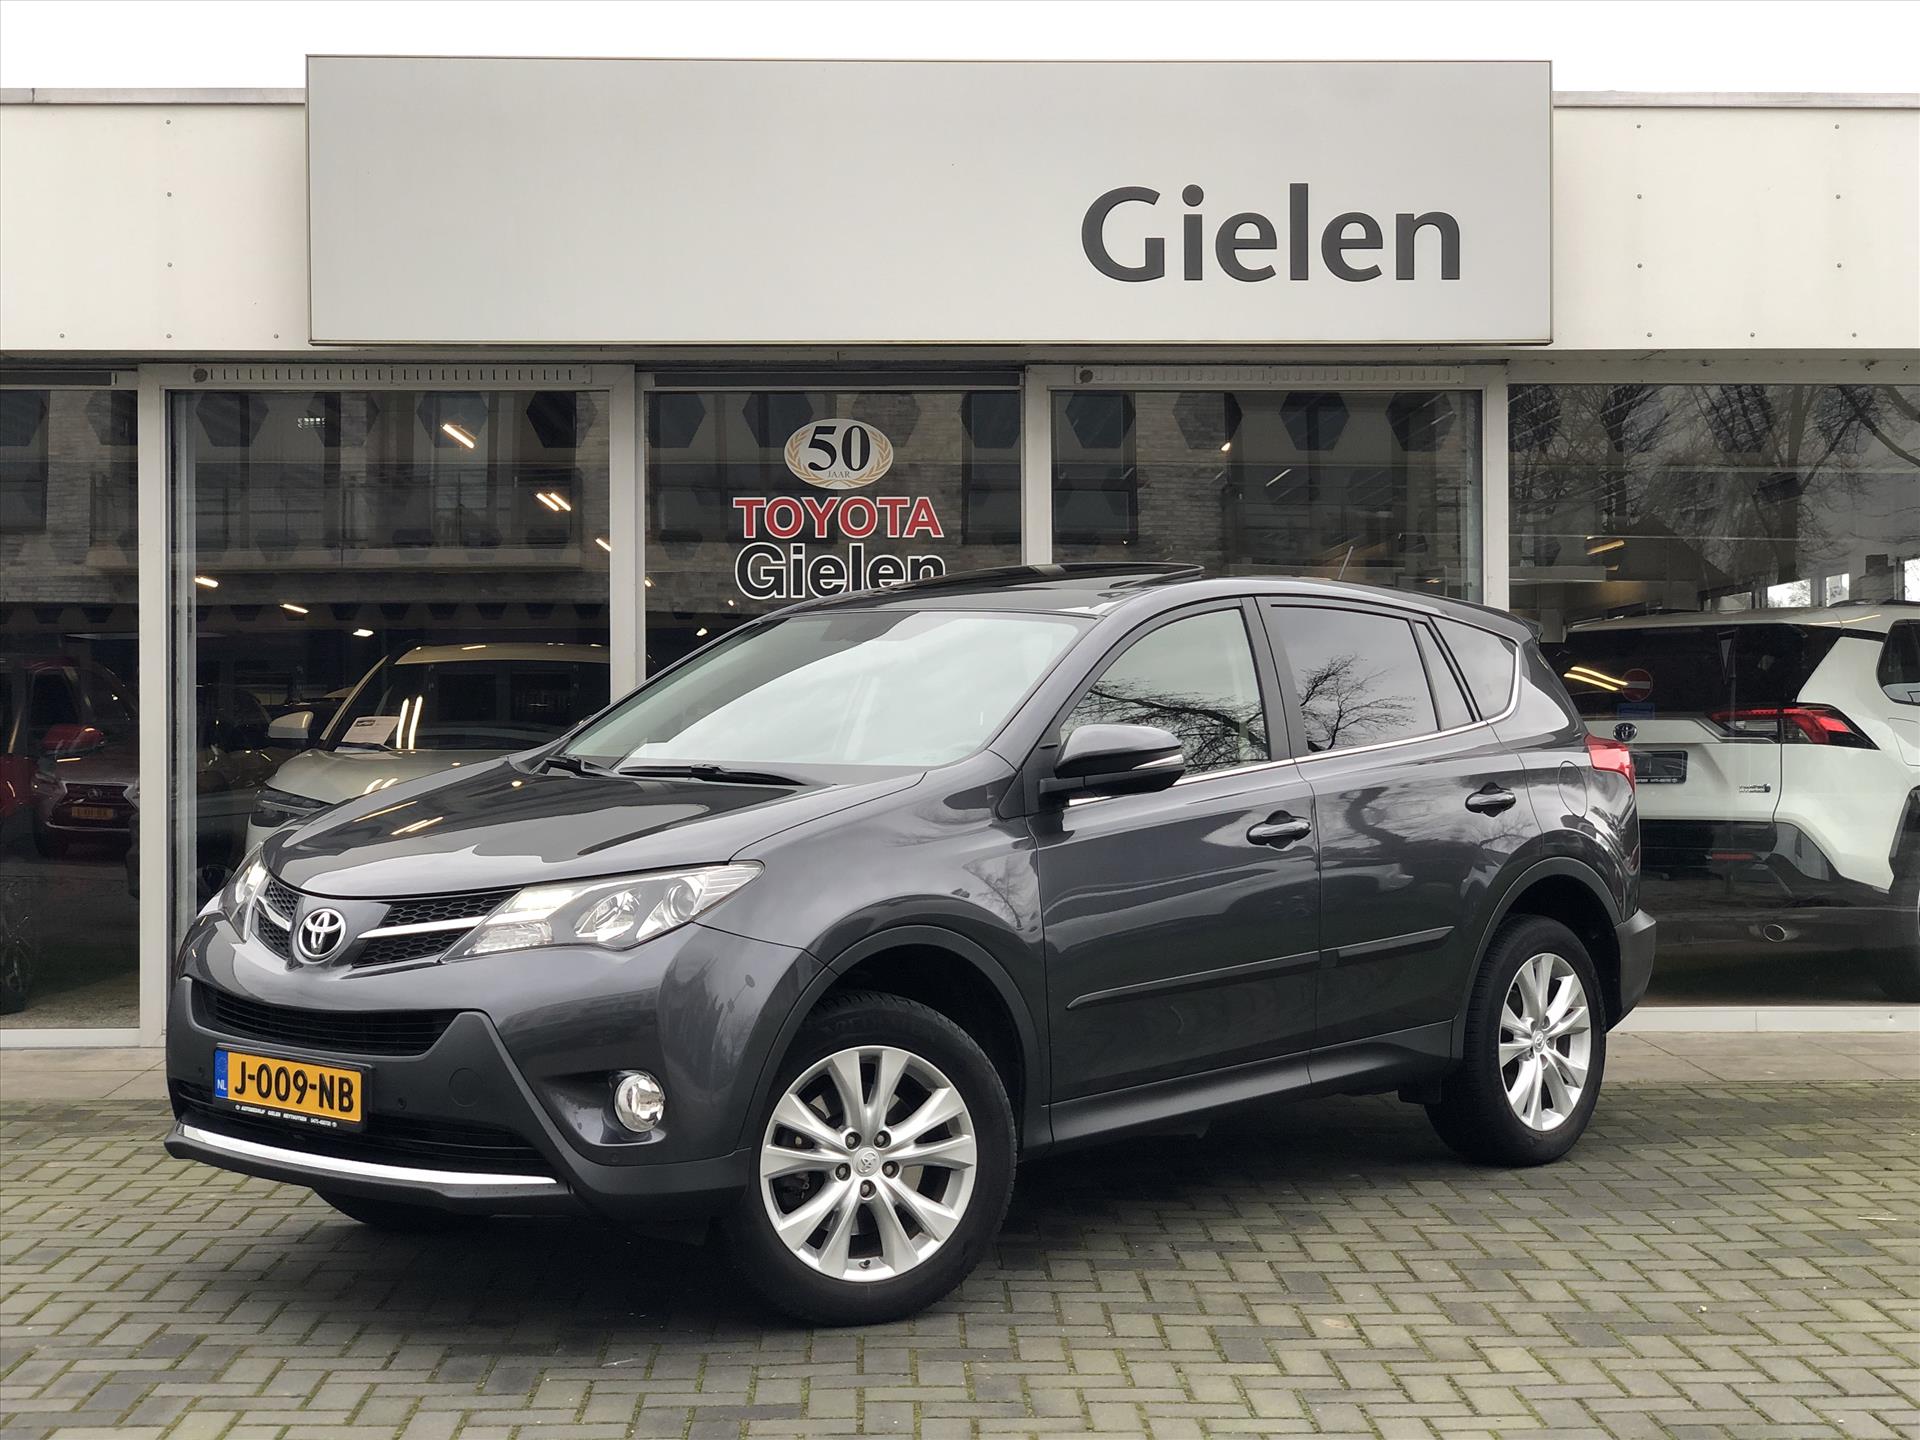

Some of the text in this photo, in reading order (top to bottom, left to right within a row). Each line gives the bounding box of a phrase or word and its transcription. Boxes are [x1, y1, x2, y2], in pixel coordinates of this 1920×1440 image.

[1081, 182, 1460, 283] Gielen
[807, 425, 871, 472] 50
[827, 470, 851, 479] JAAR
[733, 496, 944, 539] TOYOTA
[217, 1079, 227, 1091] NL
[234, 1061, 354, 1113] J-009-NB
